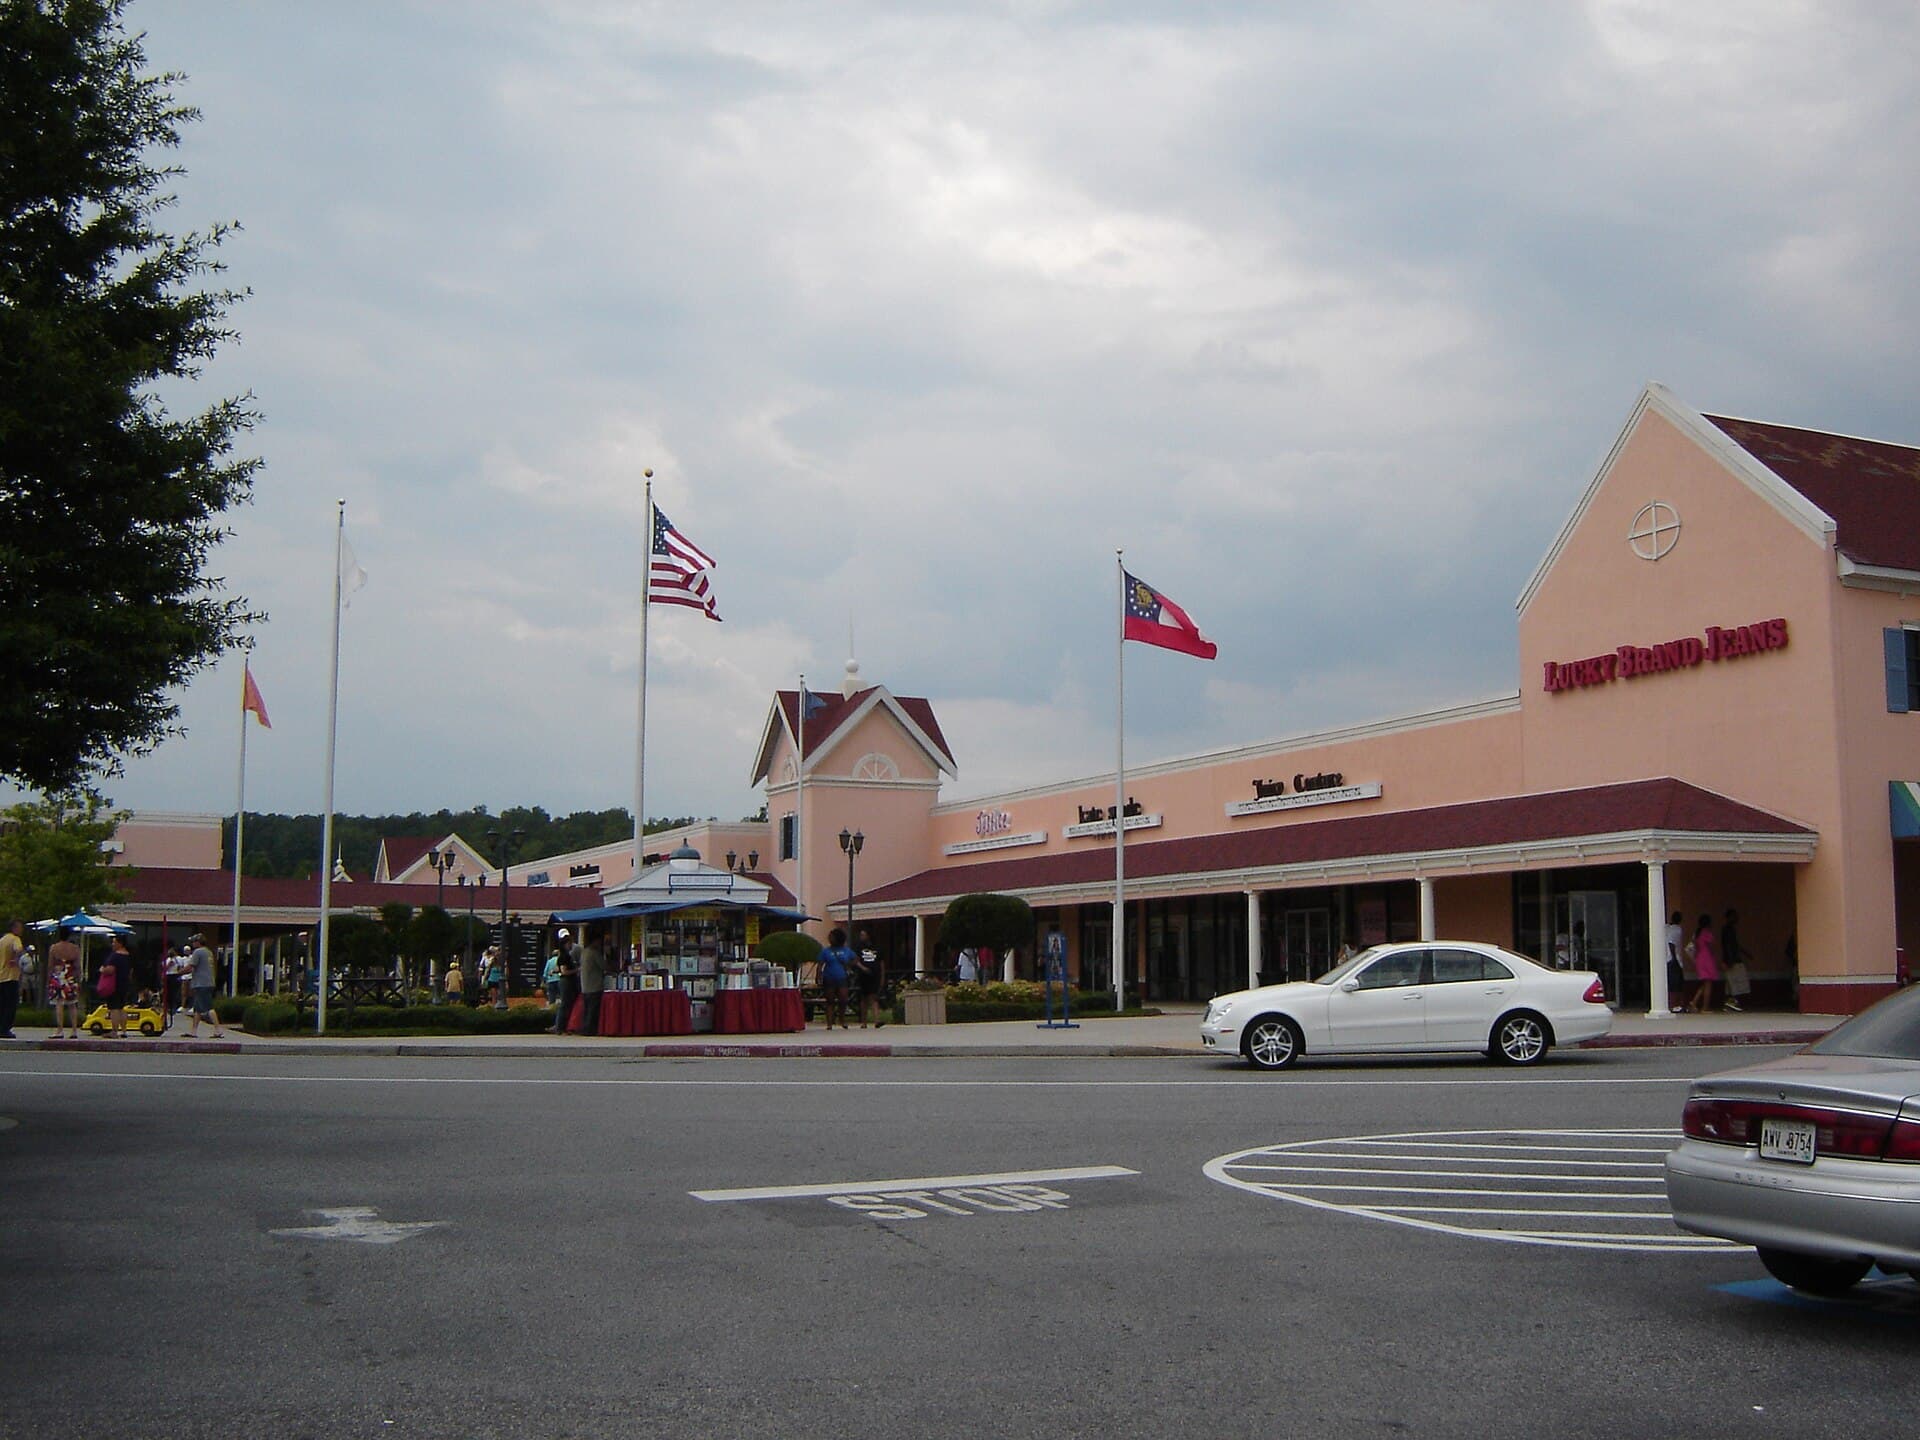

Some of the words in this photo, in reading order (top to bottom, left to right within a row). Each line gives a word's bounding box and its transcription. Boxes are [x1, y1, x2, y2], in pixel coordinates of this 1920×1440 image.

[1544, 654, 1617, 692] LUCKY
[1617, 637, 1704, 678] BRAND
[1703, 619, 1789, 661] JEANS
[827, 1184, 1070, 1220] STOP
